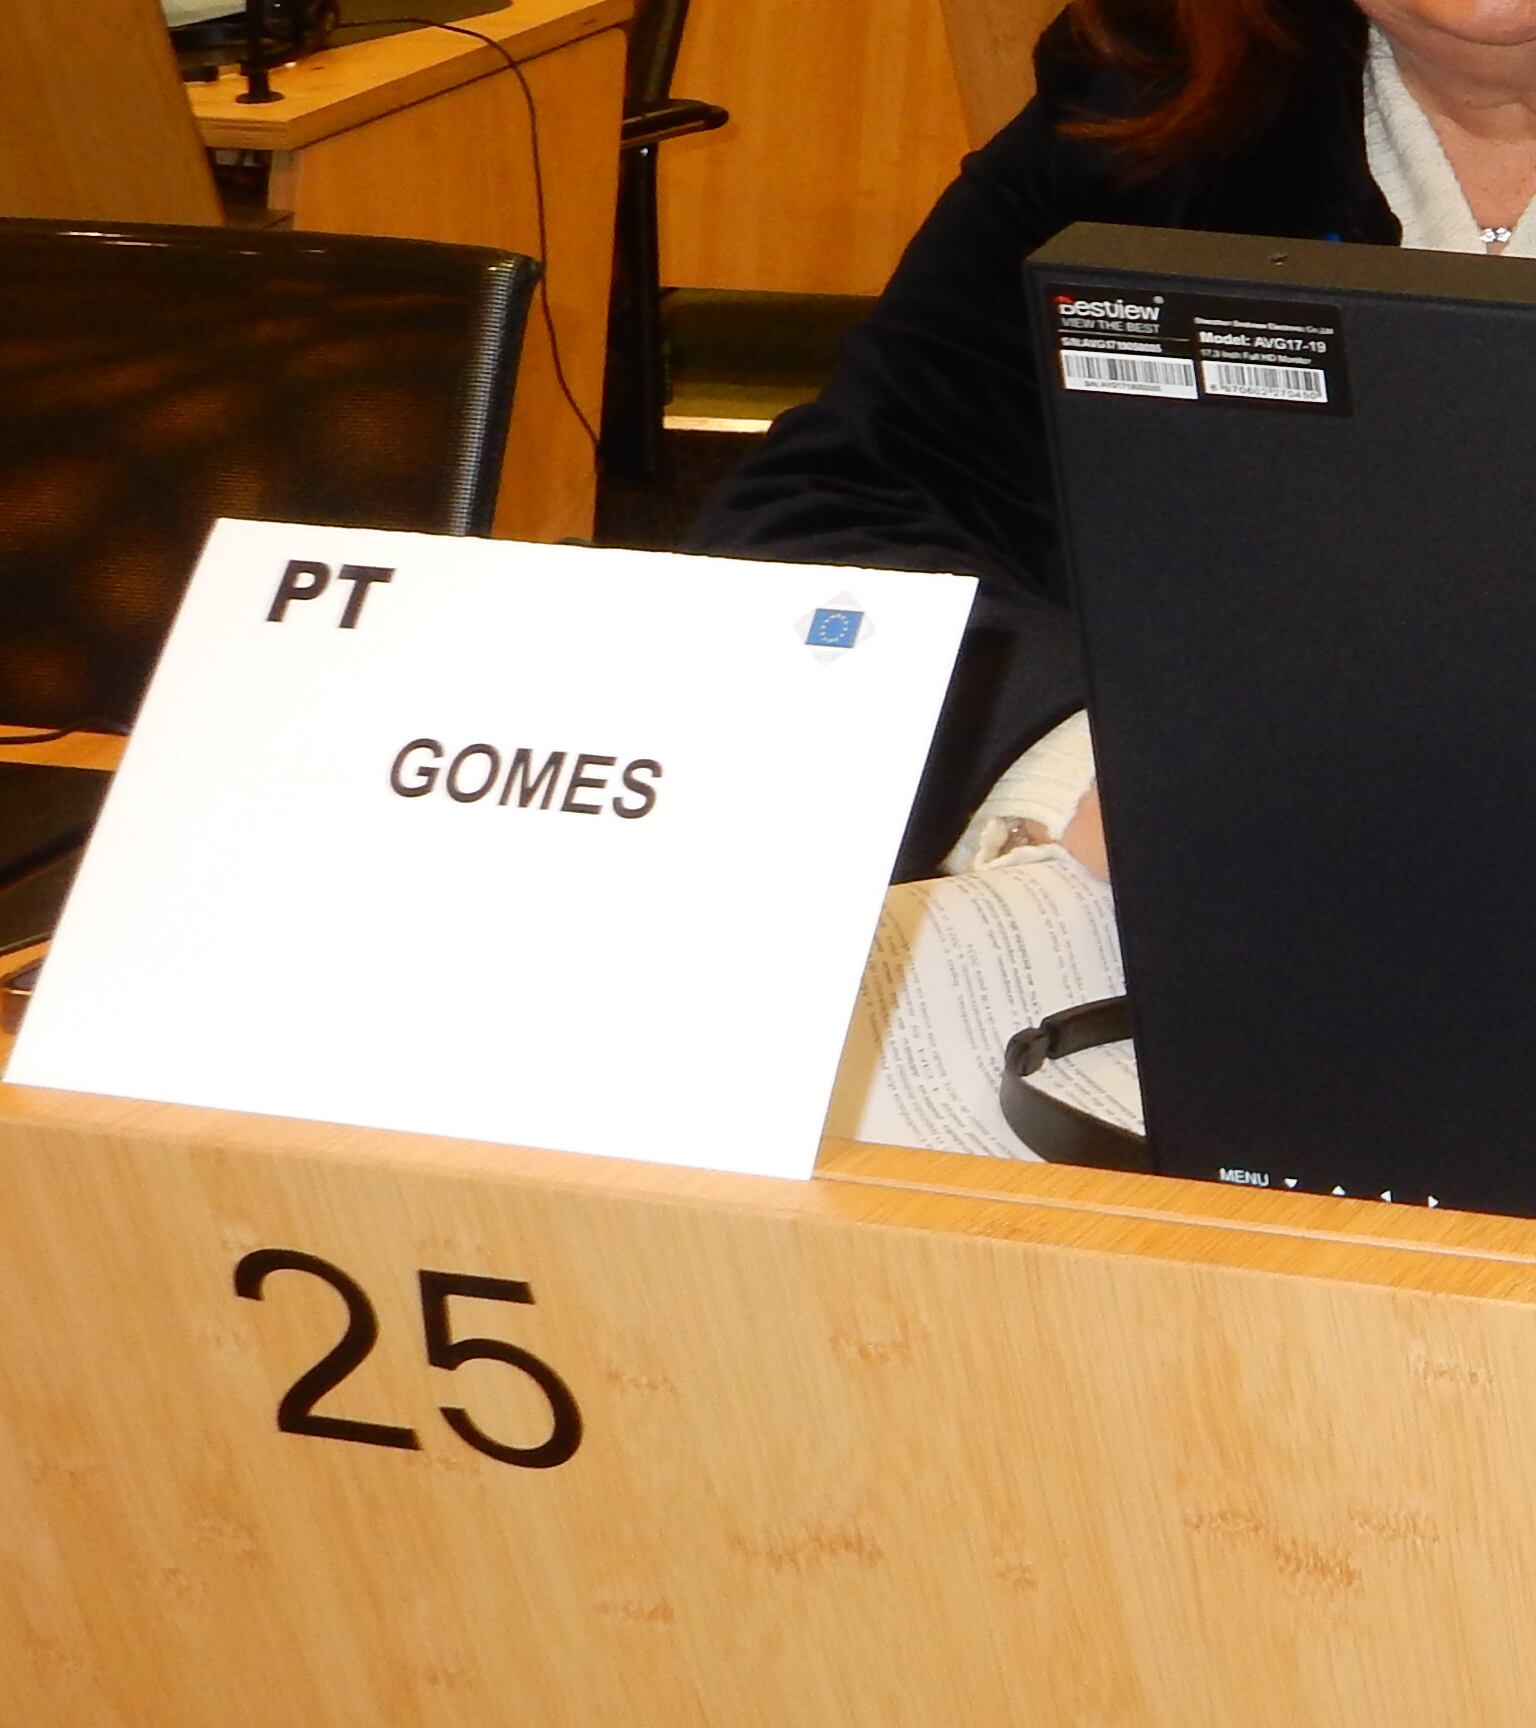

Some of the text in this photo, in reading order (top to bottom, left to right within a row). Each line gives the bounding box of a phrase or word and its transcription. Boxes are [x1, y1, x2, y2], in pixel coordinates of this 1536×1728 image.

[1253, 336, 1328, 354] AVG17-19
[265, 559, 396, 629] PT
[388, 737, 664, 820] GOMES
[1218, 1167, 1270, 1187] MENU
[233, 1247, 585, 1470] 25
